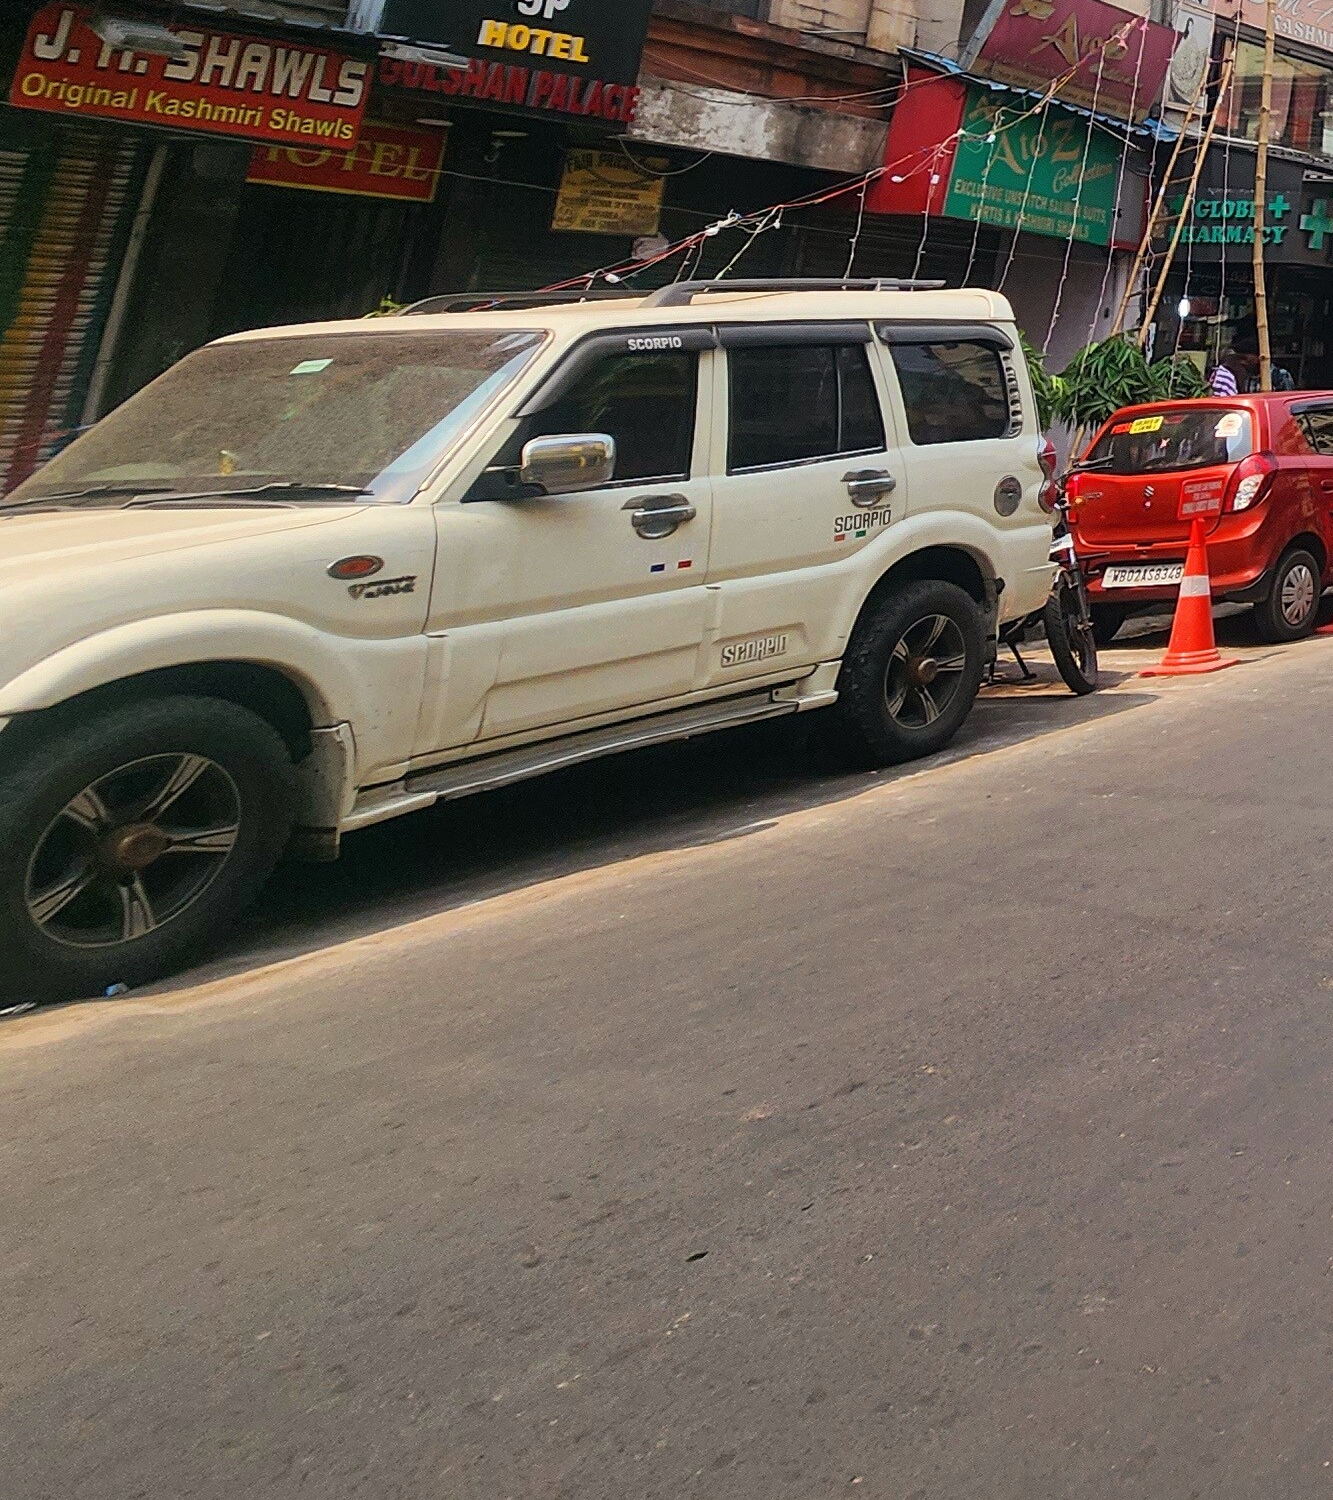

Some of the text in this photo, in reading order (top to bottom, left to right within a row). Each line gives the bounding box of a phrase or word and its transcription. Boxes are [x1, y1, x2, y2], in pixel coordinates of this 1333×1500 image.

[34, 9, 81, 63] J.
[164, 30, 369, 107] SHAWLS
[477, 19, 590, 62] HOTEL
[21, 73, 354, 139] Original Kashmiri Shawls
[380, 57, 640, 123] GULSHAN PALACE
[627, 337, 682, 350] SCORPIO
[834, 509, 892, 533] SCORPIO
[721, 634, 788, 667] SCORPIO
